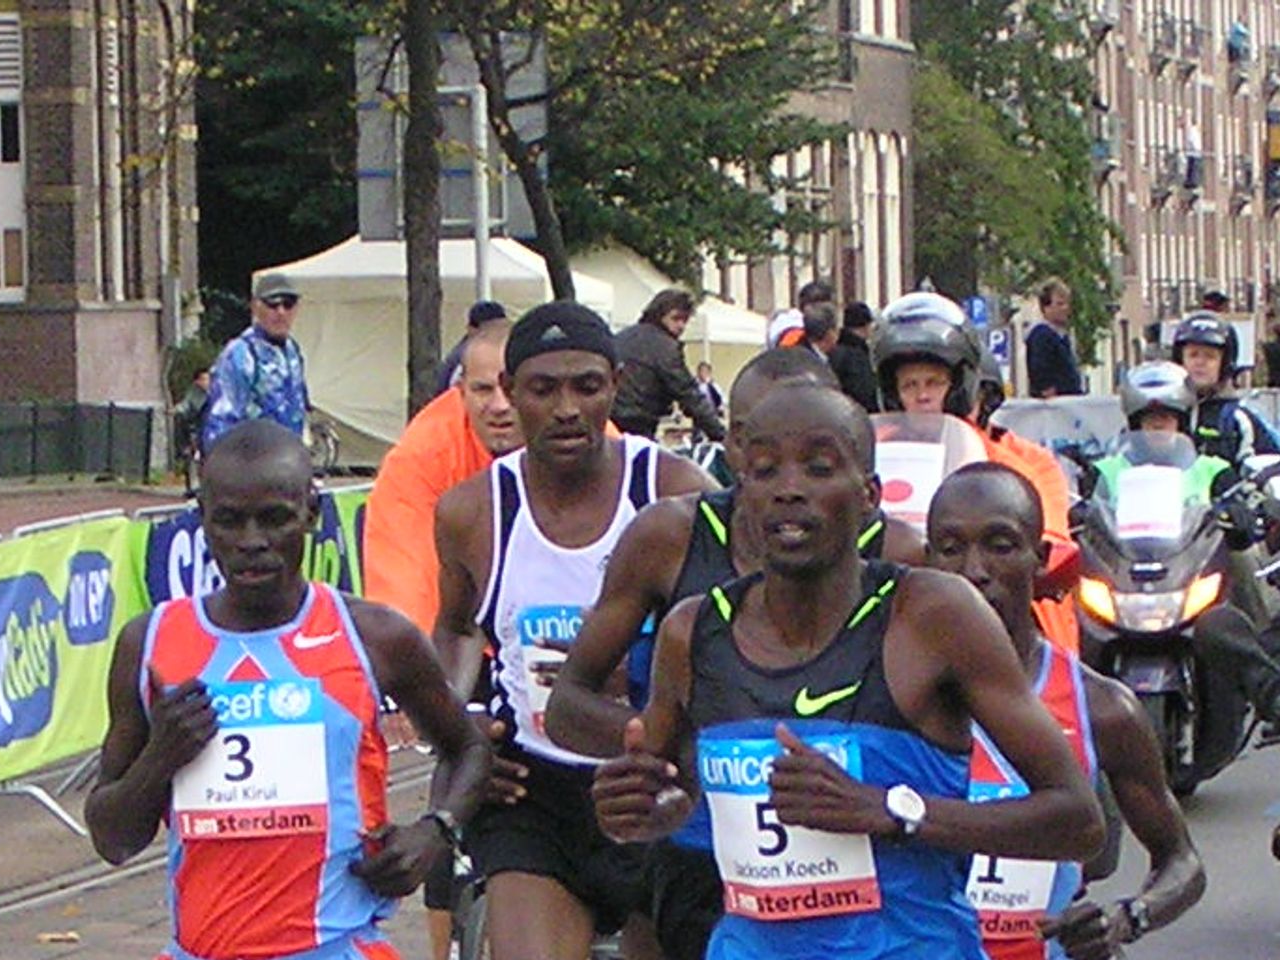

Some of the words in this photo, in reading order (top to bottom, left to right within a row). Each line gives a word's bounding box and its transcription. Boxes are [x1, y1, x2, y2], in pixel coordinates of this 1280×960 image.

[523, 610, 583, 639] unic
[223, 733, 254, 782] 3
[704, 747, 776, 786] unice
[206, 787, 237, 801] Paul
[243, 784, 278, 799] Kirui
[756, 802, 788, 856] 5
[786, 858, 839, 877] Koech
[983, 889, 1030, 907] Kosgei
